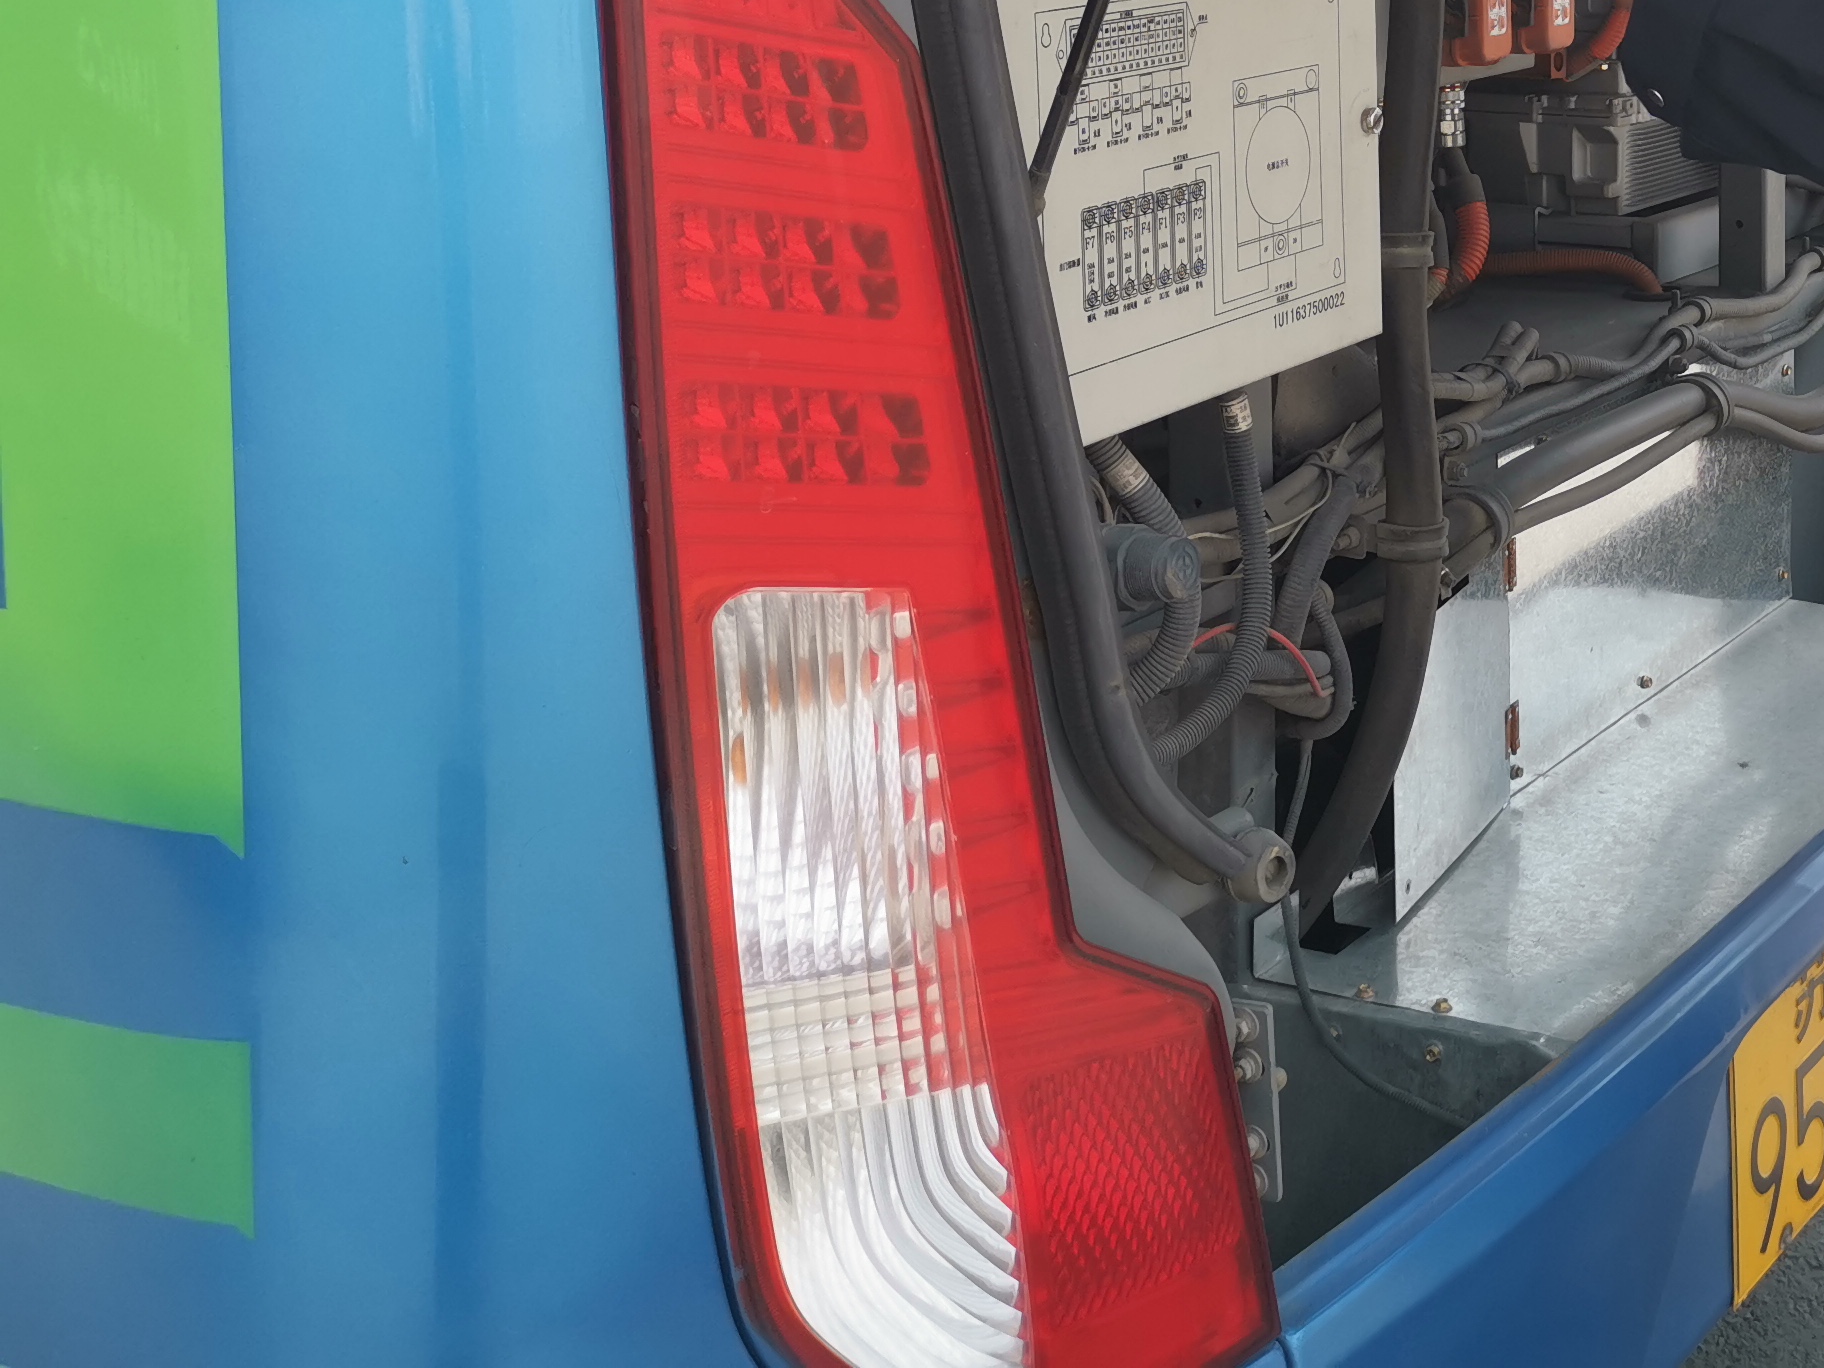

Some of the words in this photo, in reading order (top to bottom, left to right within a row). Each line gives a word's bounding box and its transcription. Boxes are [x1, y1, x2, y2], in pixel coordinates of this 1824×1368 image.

[1176, 211, 1186, 226] F3
[1193, 207, 1203, 221] F2
[1141, 221, 1151, 236] F4
[1158, 217, 1168, 231] F1
[1105, 230, 1115, 245] F6
[1123, 225, 1134, 240] F5
[1085, 235, 1096, 250] F7
[1273, 290, 1346, 329] 1U11637500022
